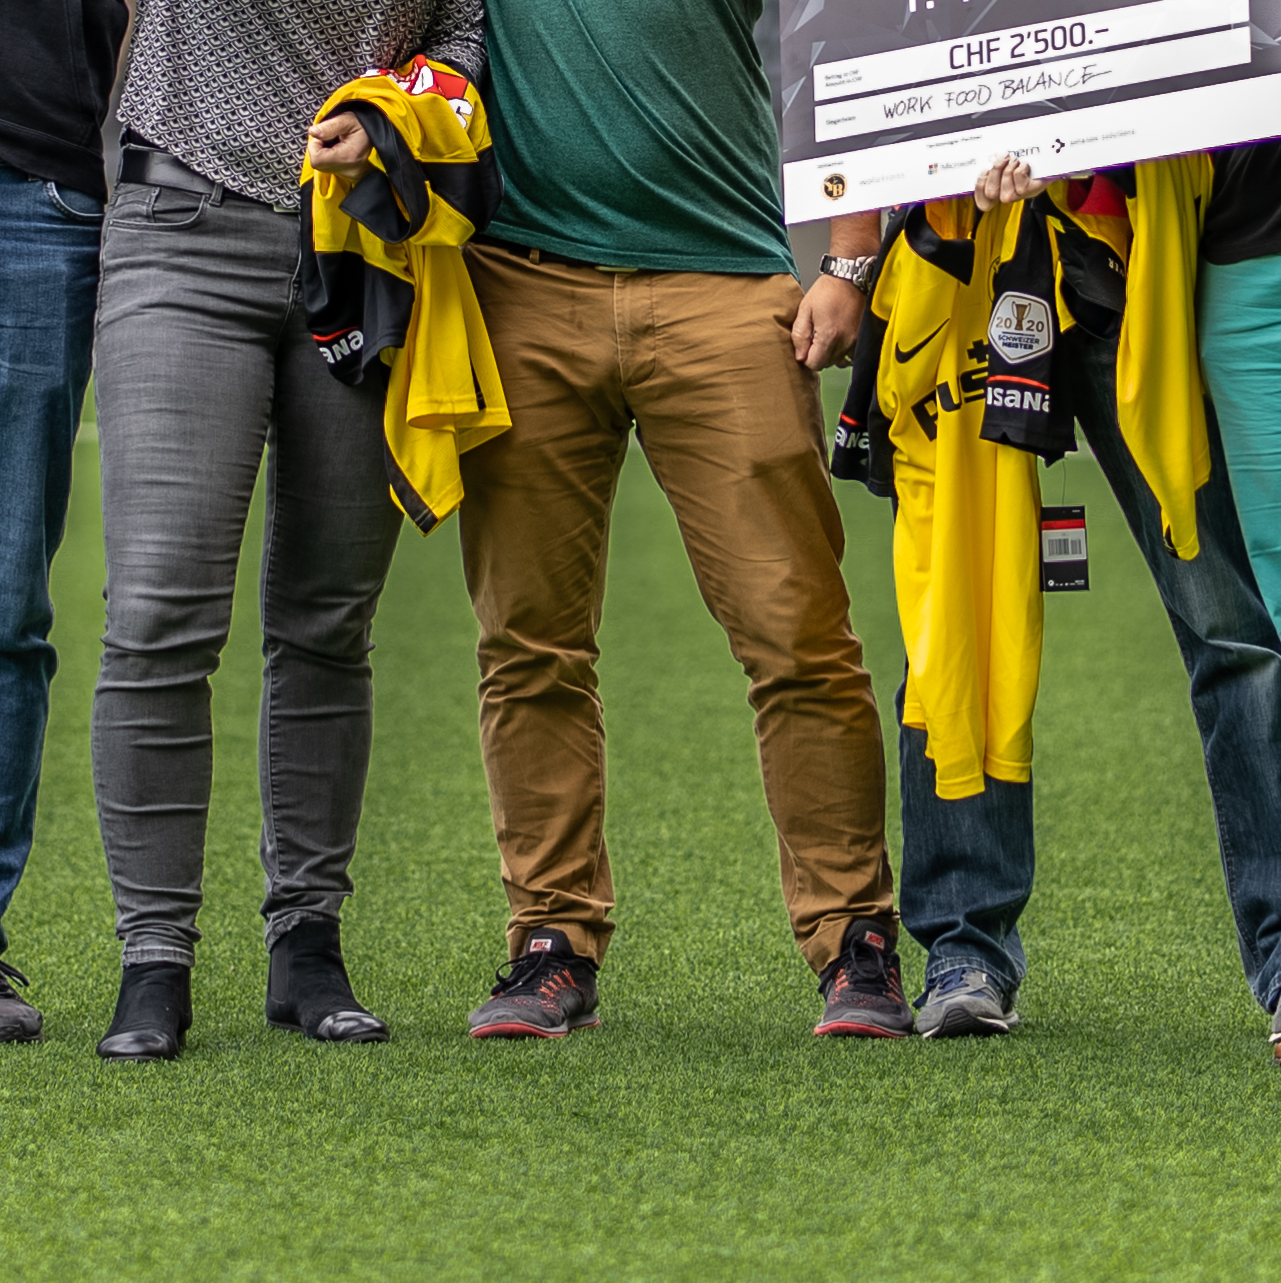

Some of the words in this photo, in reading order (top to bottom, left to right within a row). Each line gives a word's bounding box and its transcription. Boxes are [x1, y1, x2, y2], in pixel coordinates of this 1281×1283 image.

[949, 37, 1001, 70] CHF
[883, 95, 933, 119] WORK
[944, 84, 992, 108] FOOD
[999, 64, 1112, 100] BALANCE
[998, 334, 1040, 345] SCHWEIZER
[1001, 341, 1034, 350] MEISTER
